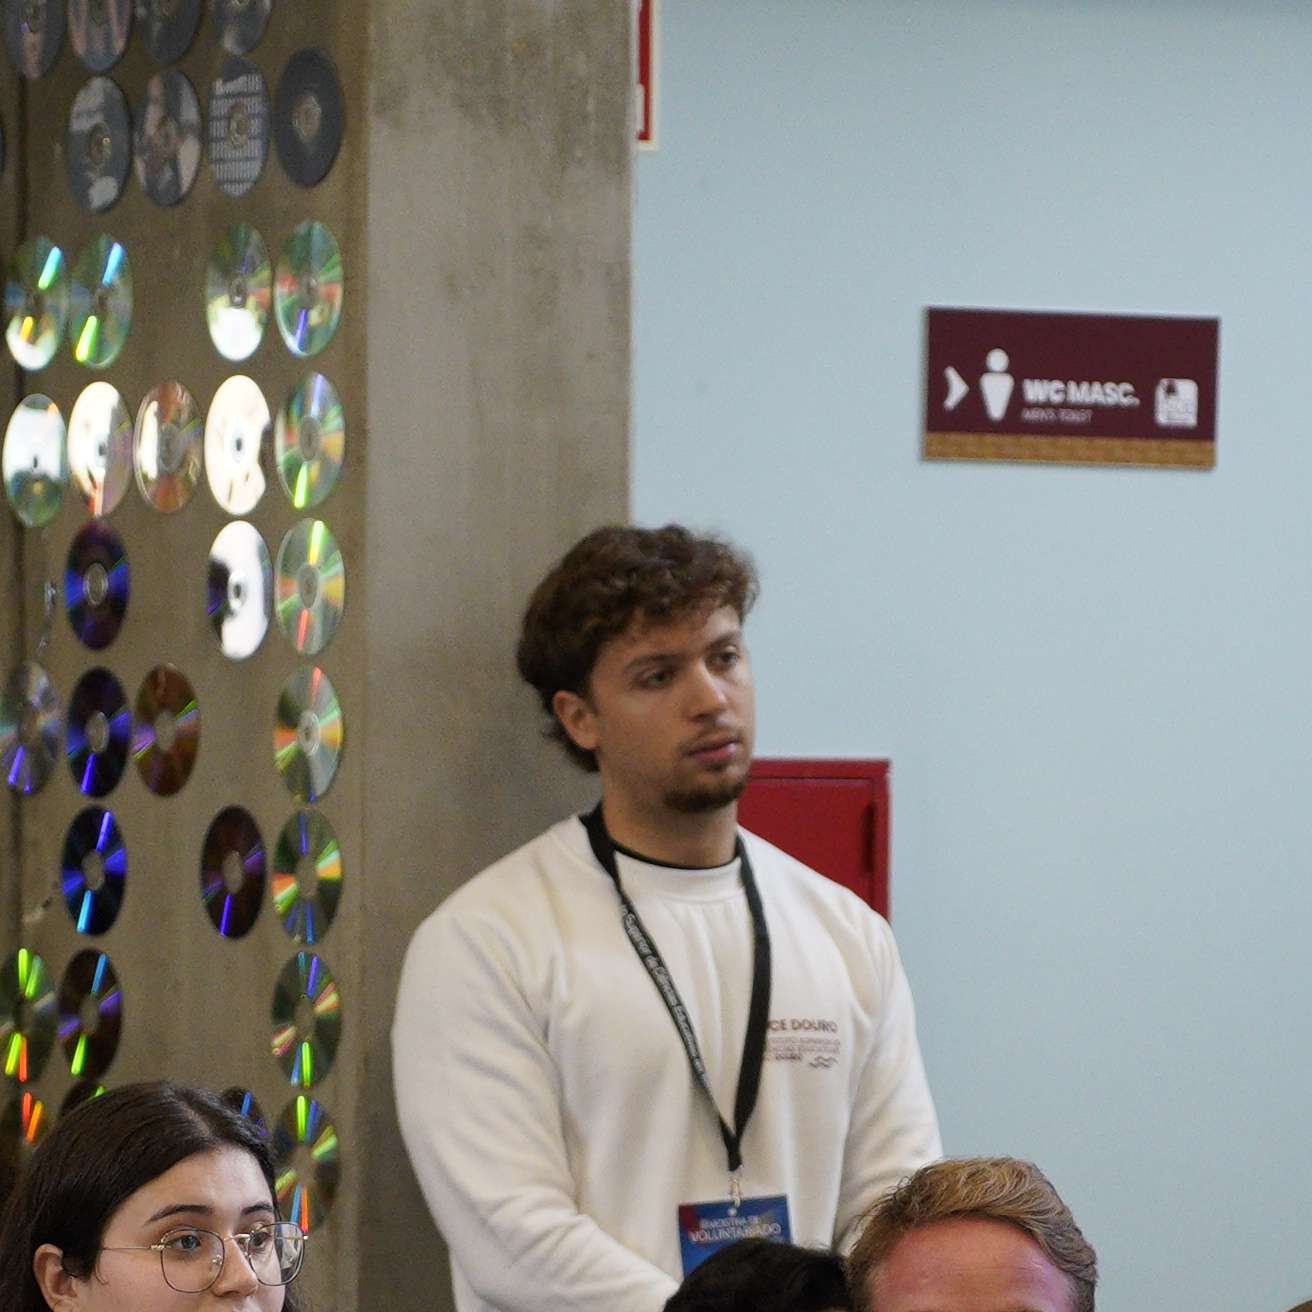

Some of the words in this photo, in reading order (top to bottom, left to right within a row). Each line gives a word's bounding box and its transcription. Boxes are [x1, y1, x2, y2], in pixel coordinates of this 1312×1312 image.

[1023, 378, 1066, 404] WC
[1067, 380, 1140, 407] MASC.
[768, 1019, 787, 1032] CE
